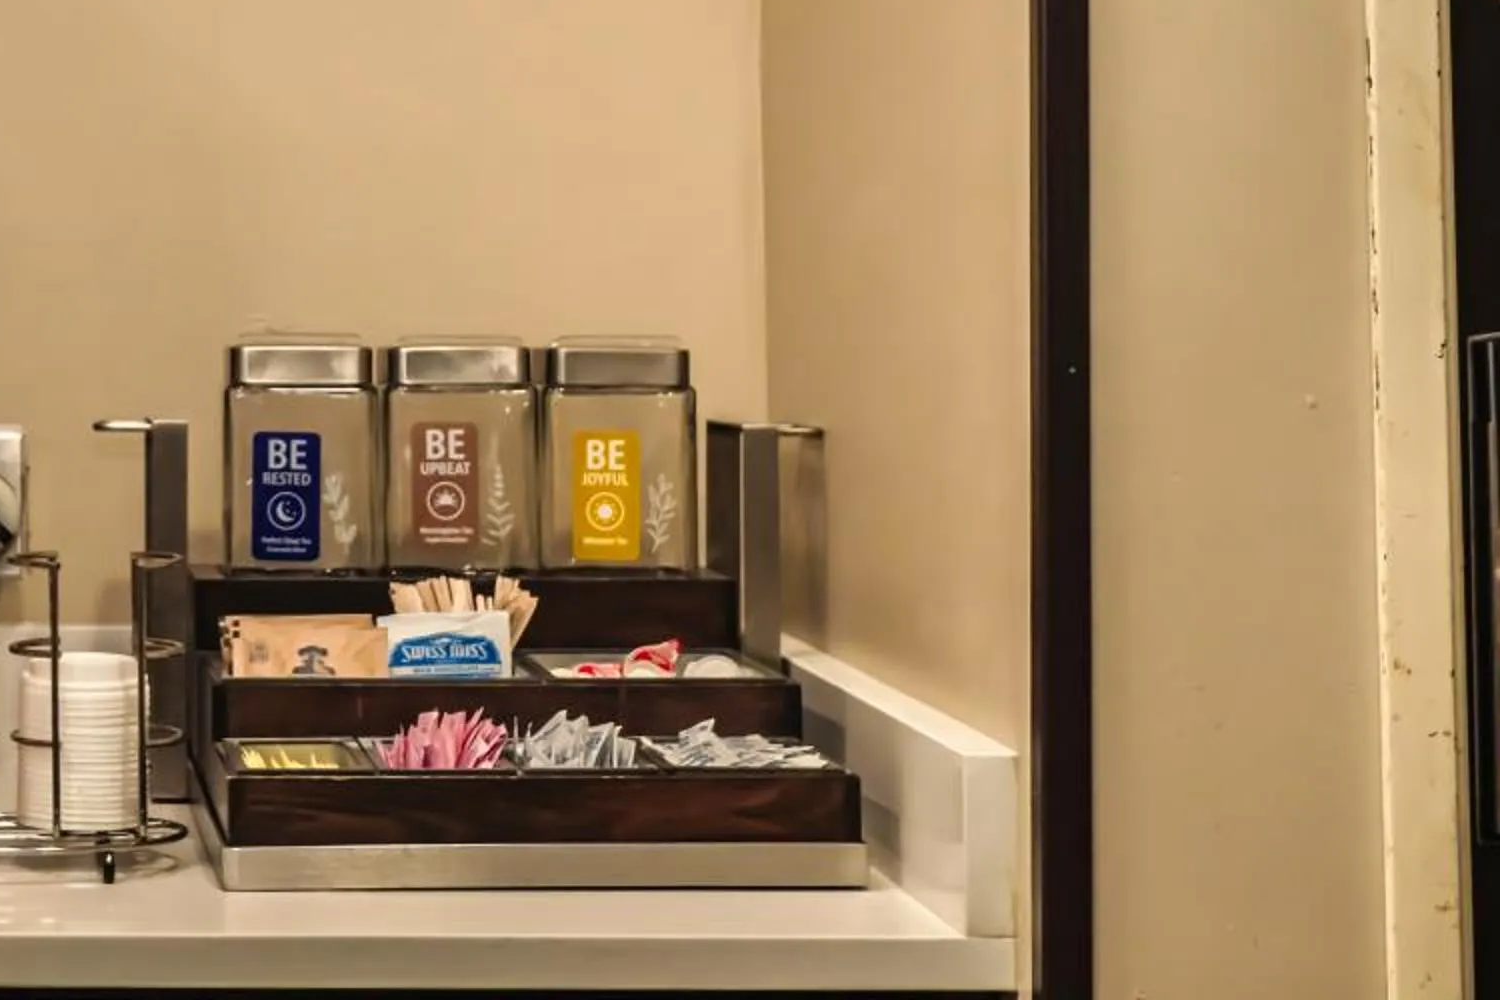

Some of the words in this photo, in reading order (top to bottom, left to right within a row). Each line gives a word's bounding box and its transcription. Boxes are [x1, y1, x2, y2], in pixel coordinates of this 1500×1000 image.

[267, 439, 308, 470] BE
[425, 429, 466, 460] BE
[586, 440, 626, 471] BE
[262, 472, 312, 487] RESTED
[420, 461, 471, 476] UPBEAT
[582, 472, 629, 487] JOYFUL
